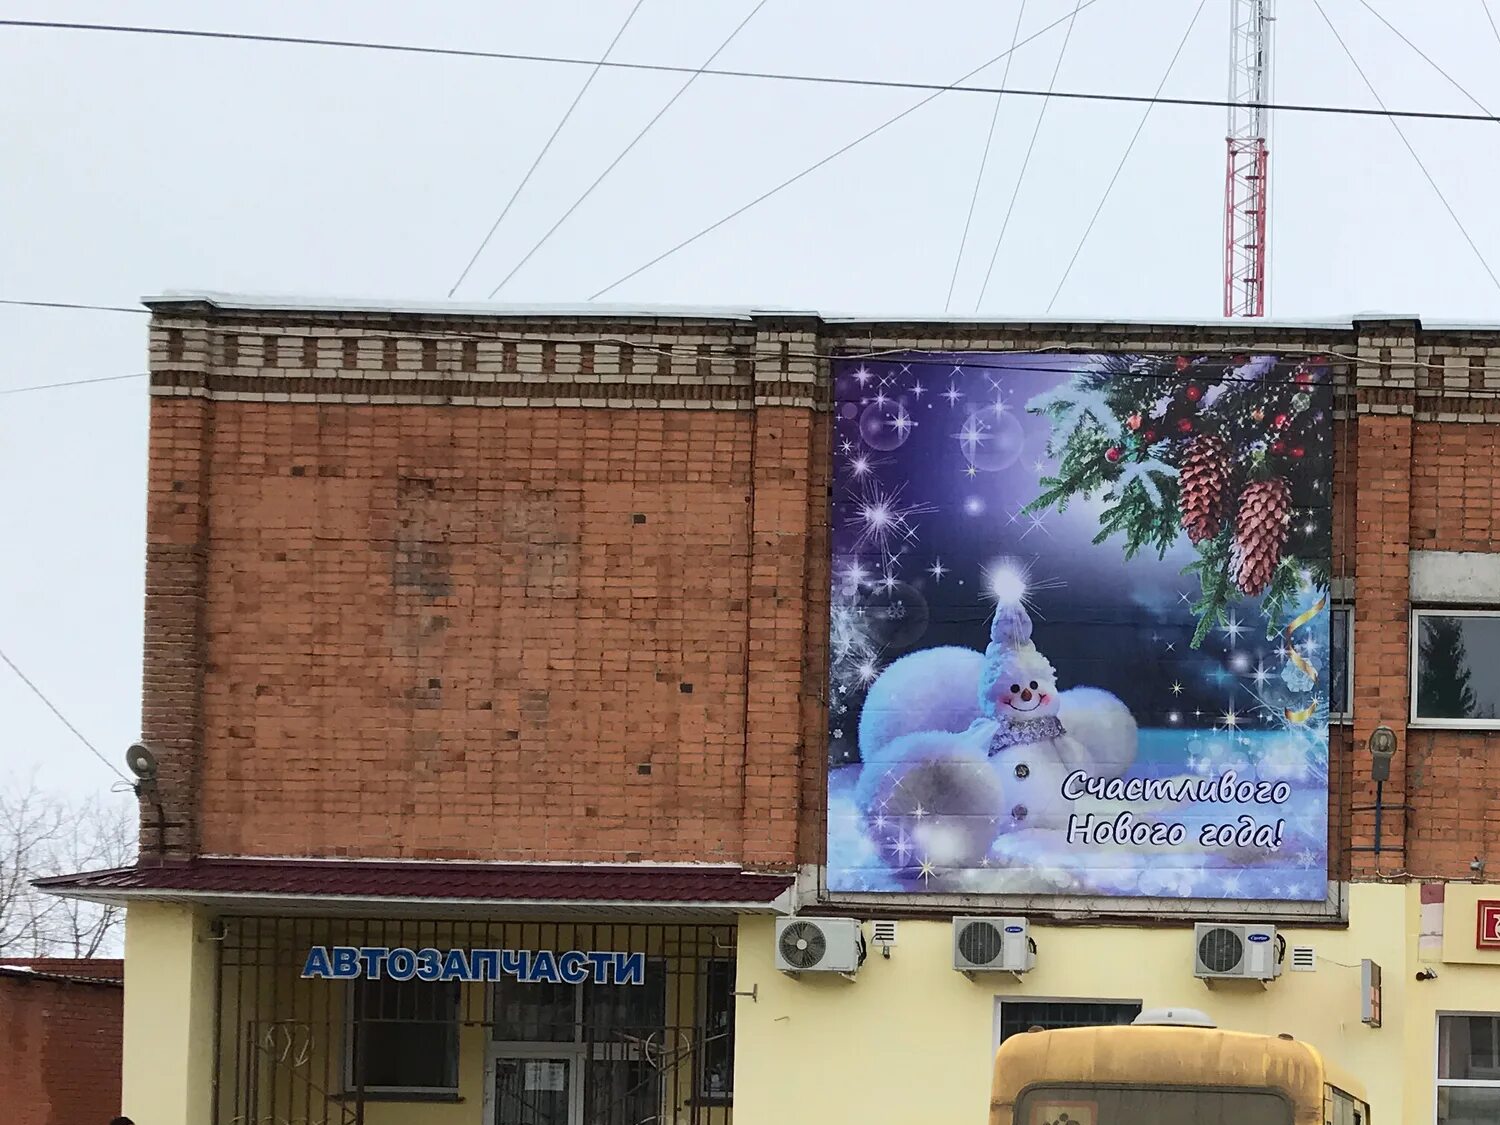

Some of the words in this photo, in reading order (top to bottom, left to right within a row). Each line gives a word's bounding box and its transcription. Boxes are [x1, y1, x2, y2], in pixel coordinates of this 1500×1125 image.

[1061, 769, 1291, 804] Счастливого
[1067, 811, 1187, 845] Нового
[1200, 815, 1286, 848] года!
[301, 946, 645, 985] АВТОЗАПЧАСТИ
